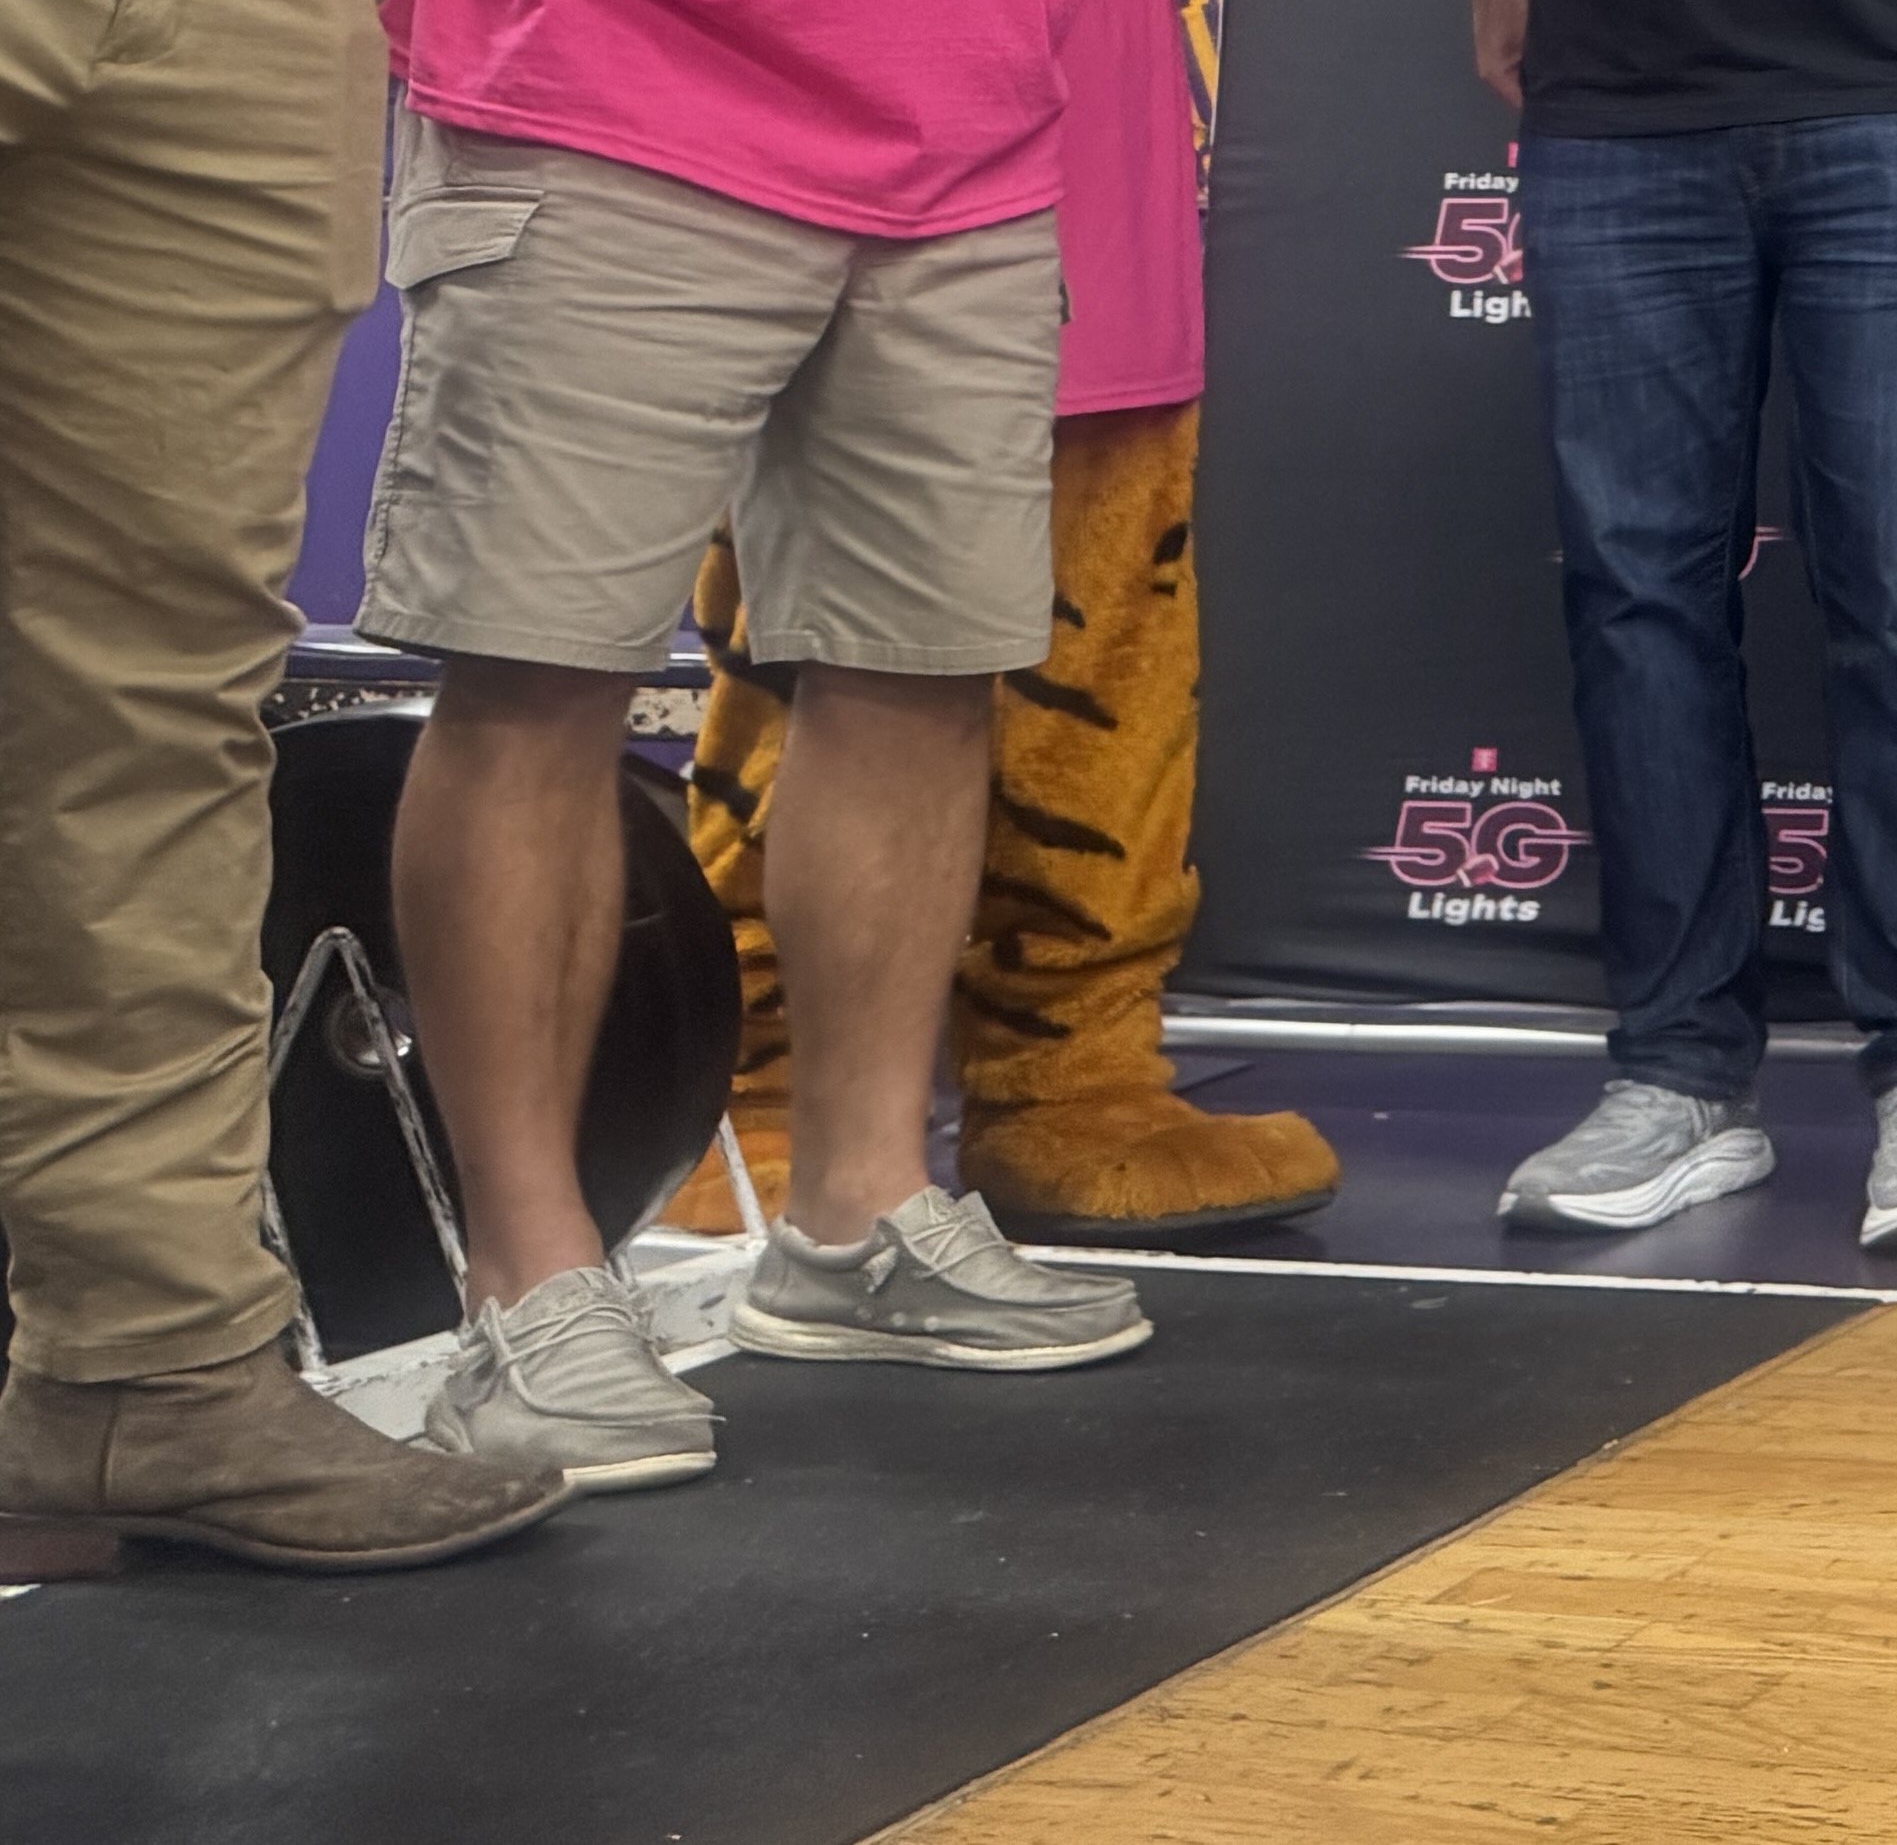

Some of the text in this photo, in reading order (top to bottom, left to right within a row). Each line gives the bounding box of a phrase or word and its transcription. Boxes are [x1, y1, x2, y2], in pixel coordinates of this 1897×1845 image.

[1443, 172, 1519, 193] Friday
[1426, 197, 1521, 285] 5
[1450, 290, 1532, 324] Ligh
[1405, 775, 1561, 799] Friday Night
[1383, 800, 1576, 889] 5G
[1408, 892, 1540, 925] Lights
